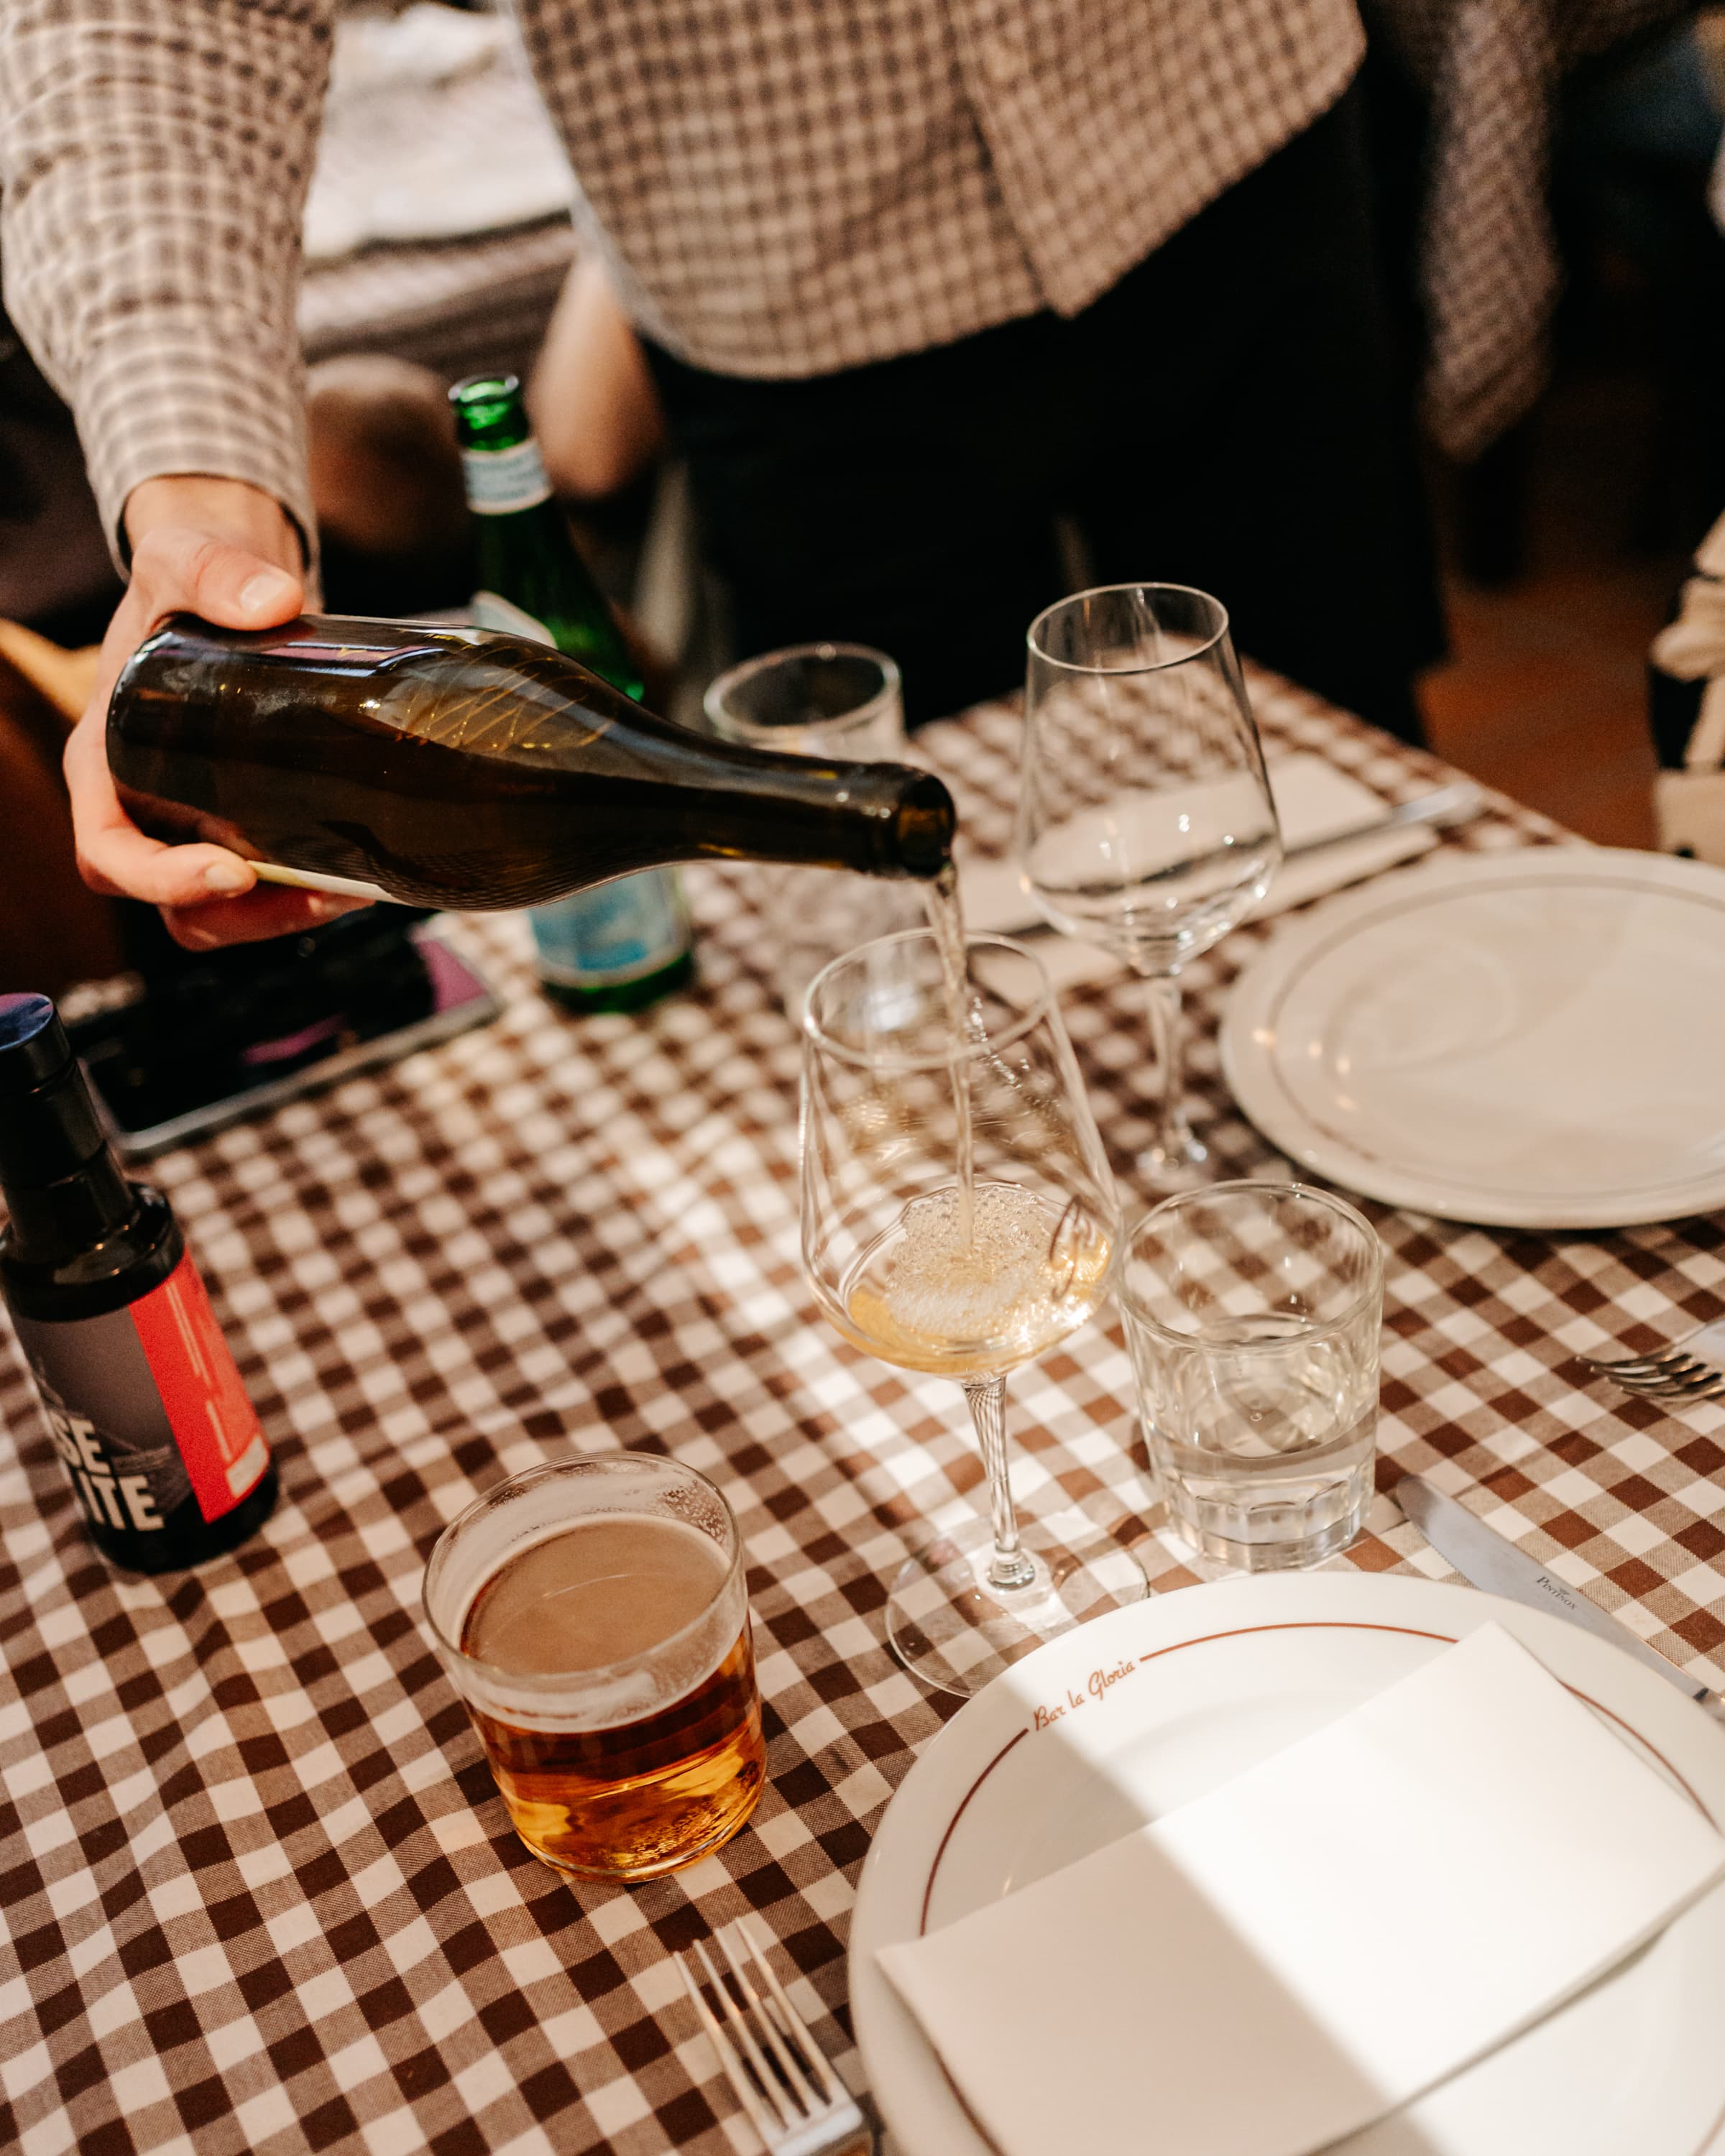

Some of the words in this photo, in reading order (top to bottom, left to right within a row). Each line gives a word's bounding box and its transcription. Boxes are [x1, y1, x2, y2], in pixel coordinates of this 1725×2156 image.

[1033, 1705, 1066, 1731] Bar
[1067, 1690, 1085, 1709] la
[1087, 1661, 1136, 1700] Gloria
